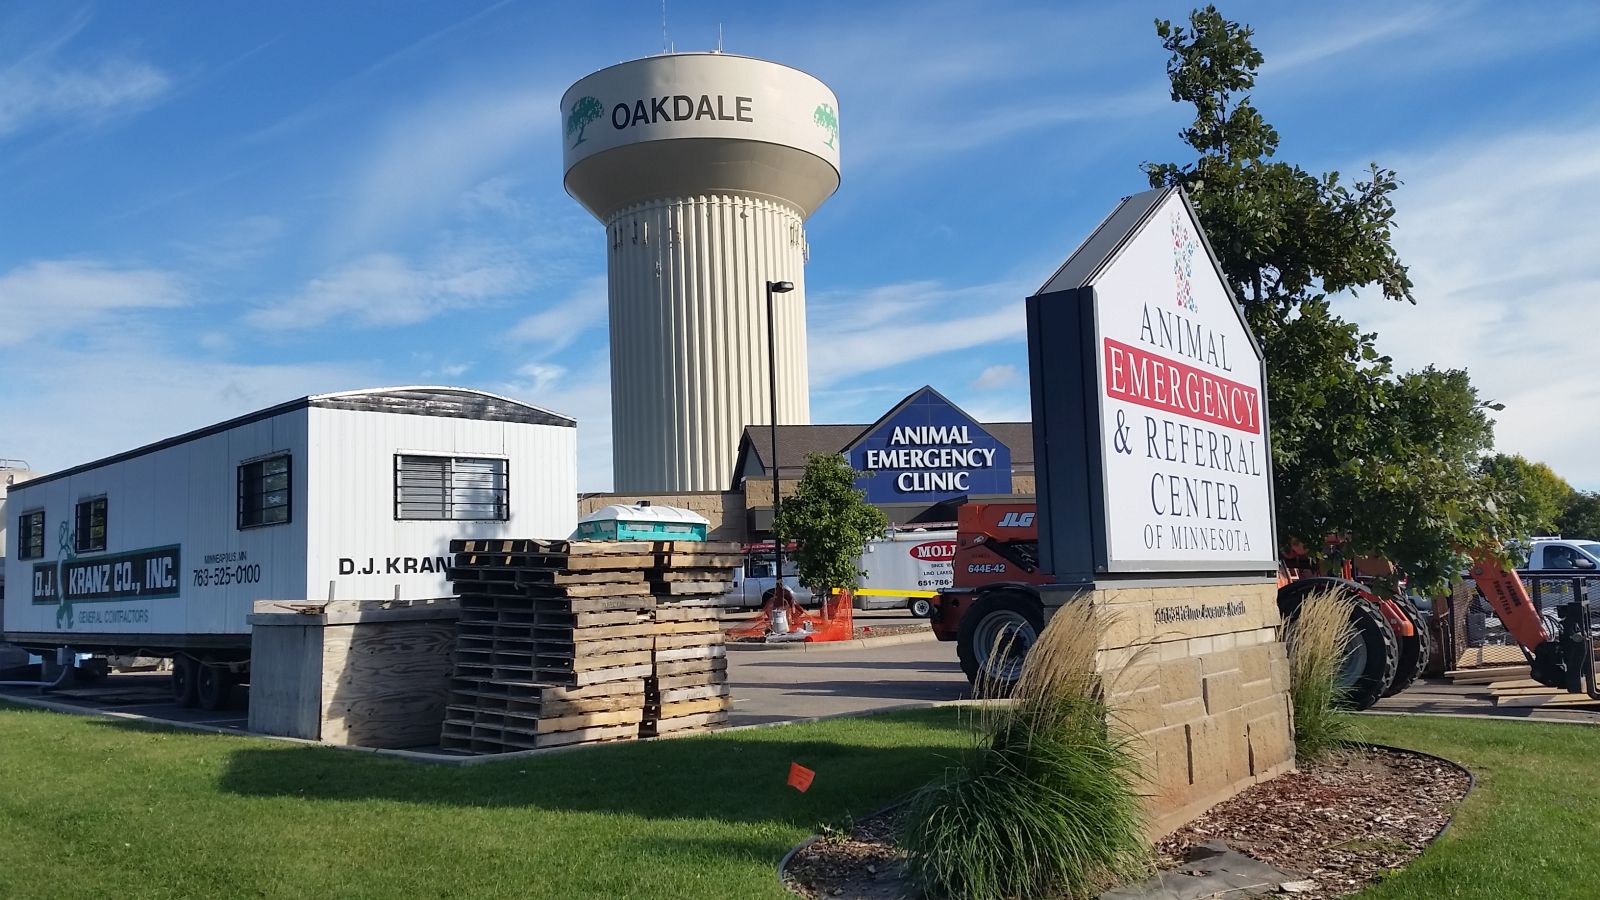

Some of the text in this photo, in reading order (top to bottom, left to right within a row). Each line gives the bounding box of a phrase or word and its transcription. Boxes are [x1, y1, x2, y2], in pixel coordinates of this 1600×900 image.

[611, 95, 754, 130] OAKDALE
[1140, 301, 1232, 372] ANIMAL
[1109, 346, 1256, 428] EMERGENCY
[890, 425, 973, 446] ANIMAL
[1114, 409, 1261, 477] & REFERRAL
[867, 448, 997, 469] EMERGENCY
[897, 471, 970, 492] CLINIC
[1151, 472, 1243, 522] CENTER
[998, 512, 1036, 527] JLG
[1144, 523, 1251, 552] OF MINNESOTA
[34, 556, 177, 597] D.J. KRANZ CO., INC.
[193, 563, 261, 587] 763-525-0100
[338, 557, 381, 576] D.J.
[967, 564, 1006, 573] 644E-42
